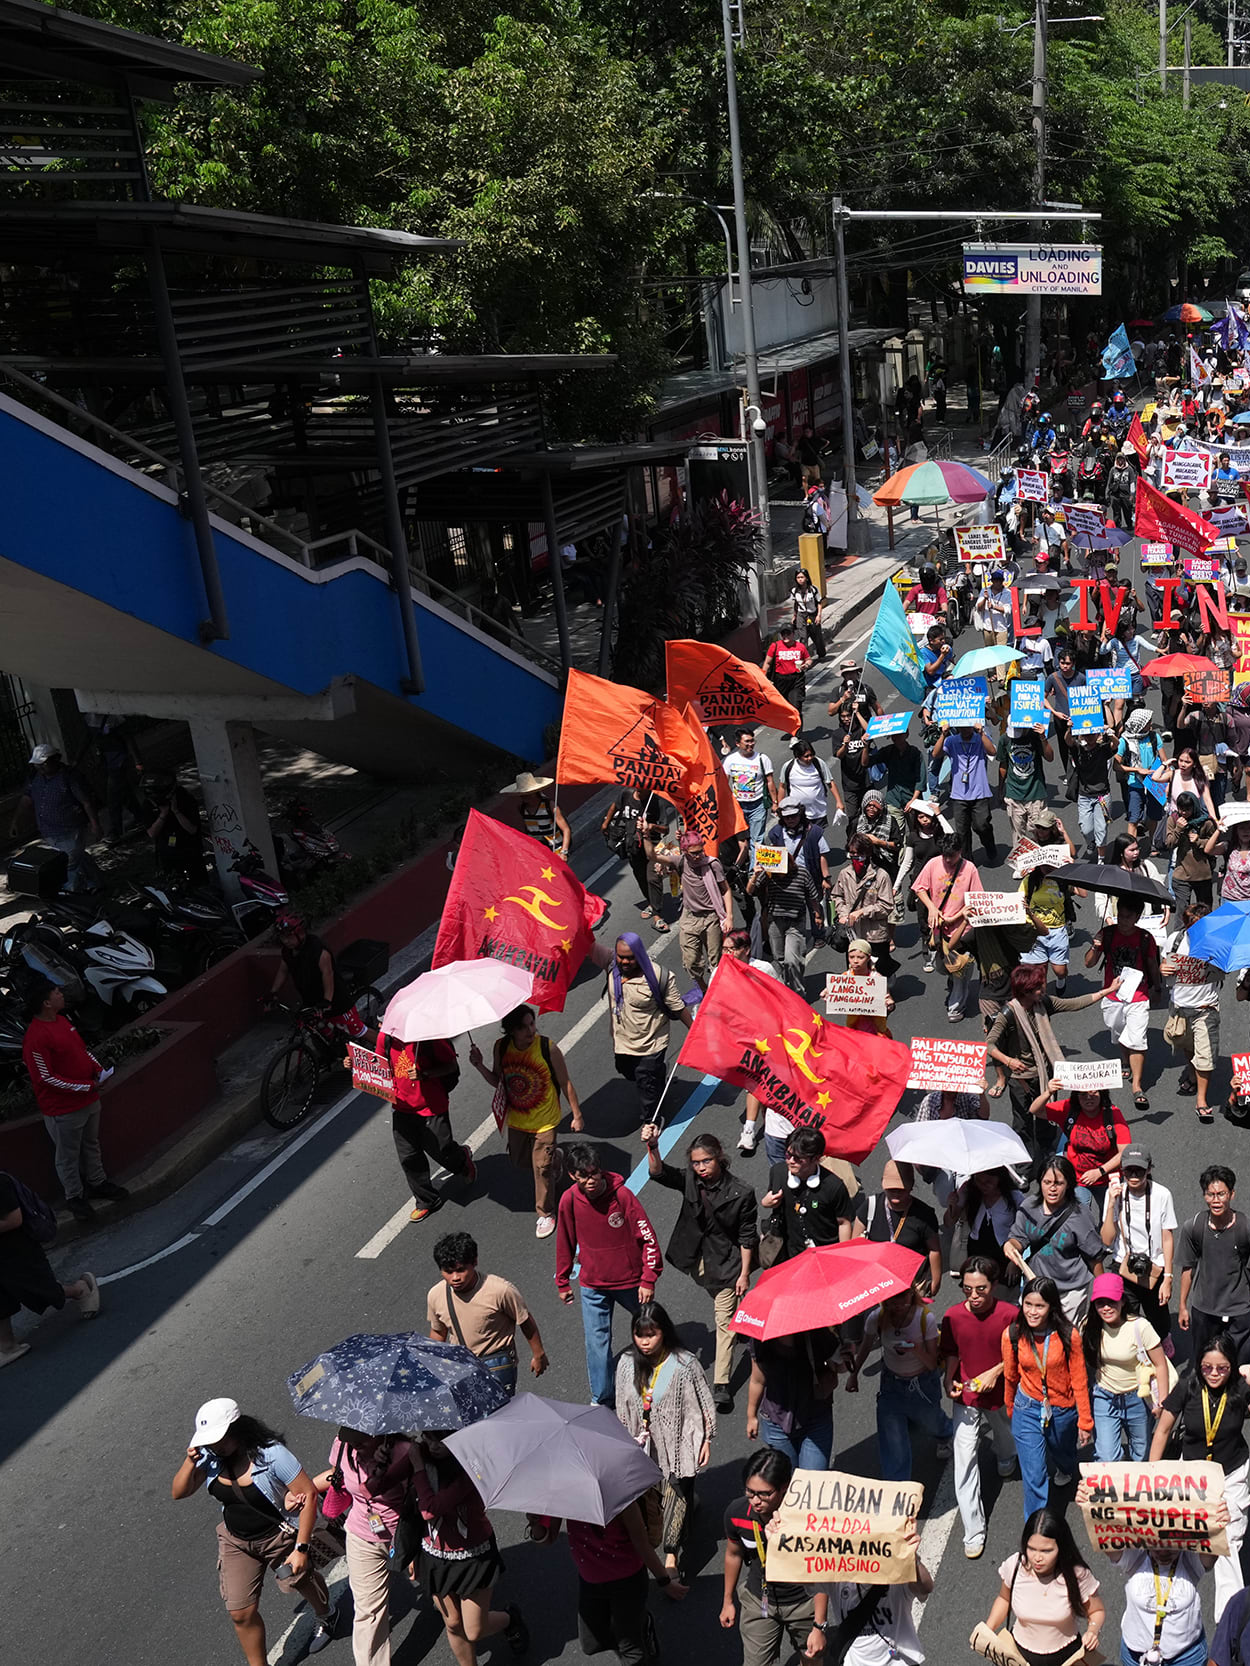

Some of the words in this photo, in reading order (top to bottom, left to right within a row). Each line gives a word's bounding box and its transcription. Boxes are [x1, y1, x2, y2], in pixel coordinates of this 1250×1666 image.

[1029, 249, 1090, 262] LOADING
[966, 261, 1016, 275] DAVIES
[1020, 271, 1100, 284] UNLOADING
[1184, 671, 1208, 686] STOP
[1211, 671, 1230, 685] THE
[1069, 684, 1099, 699] BUWIS
[700, 692, 766, 711] PANDAY
[956, 697, 970, 710] VAT
[704, 704, 757, 719] SINING
[613, 757, 682, 781] PANDAY
[614, 772, 680, 794] SINING
[968, 893, 1004, 901] SERBISYO
[477, 933, 560, 984] ANAKBAYAN
[865, 977, 876, 987] SA
[911, 1040, 976, 1055] BALIKTARIN
[933, 1053, 984, 1068] TATSULOK
[739, 1049, 828, 1131] ANAKBAYAN
[838, 1292, 869, 1312] Focused
[868, 1285, 880, 1298] on
[879, 1278, 895, 1292] You
[1087, 1474, 1118, 1504] SA
[1122, 1474, 1209, 1504] LABAN
[781, 1480, 813, 1511] SA
[817, 1485, 884, 1517] LABAN
[891, 1491, 918, 1518] NG
[1091, 1507, 1115, 1521] NG
[1117, 1506, 1210, 1531] TSUPER
[1094, 1524, 1156, 1538] KASAMA
[777, 1536, 852, 1560] KASAMA
[853, 1538, 892, 1560] ANG
[804, 1556, 880, 1574] TOMASINO
